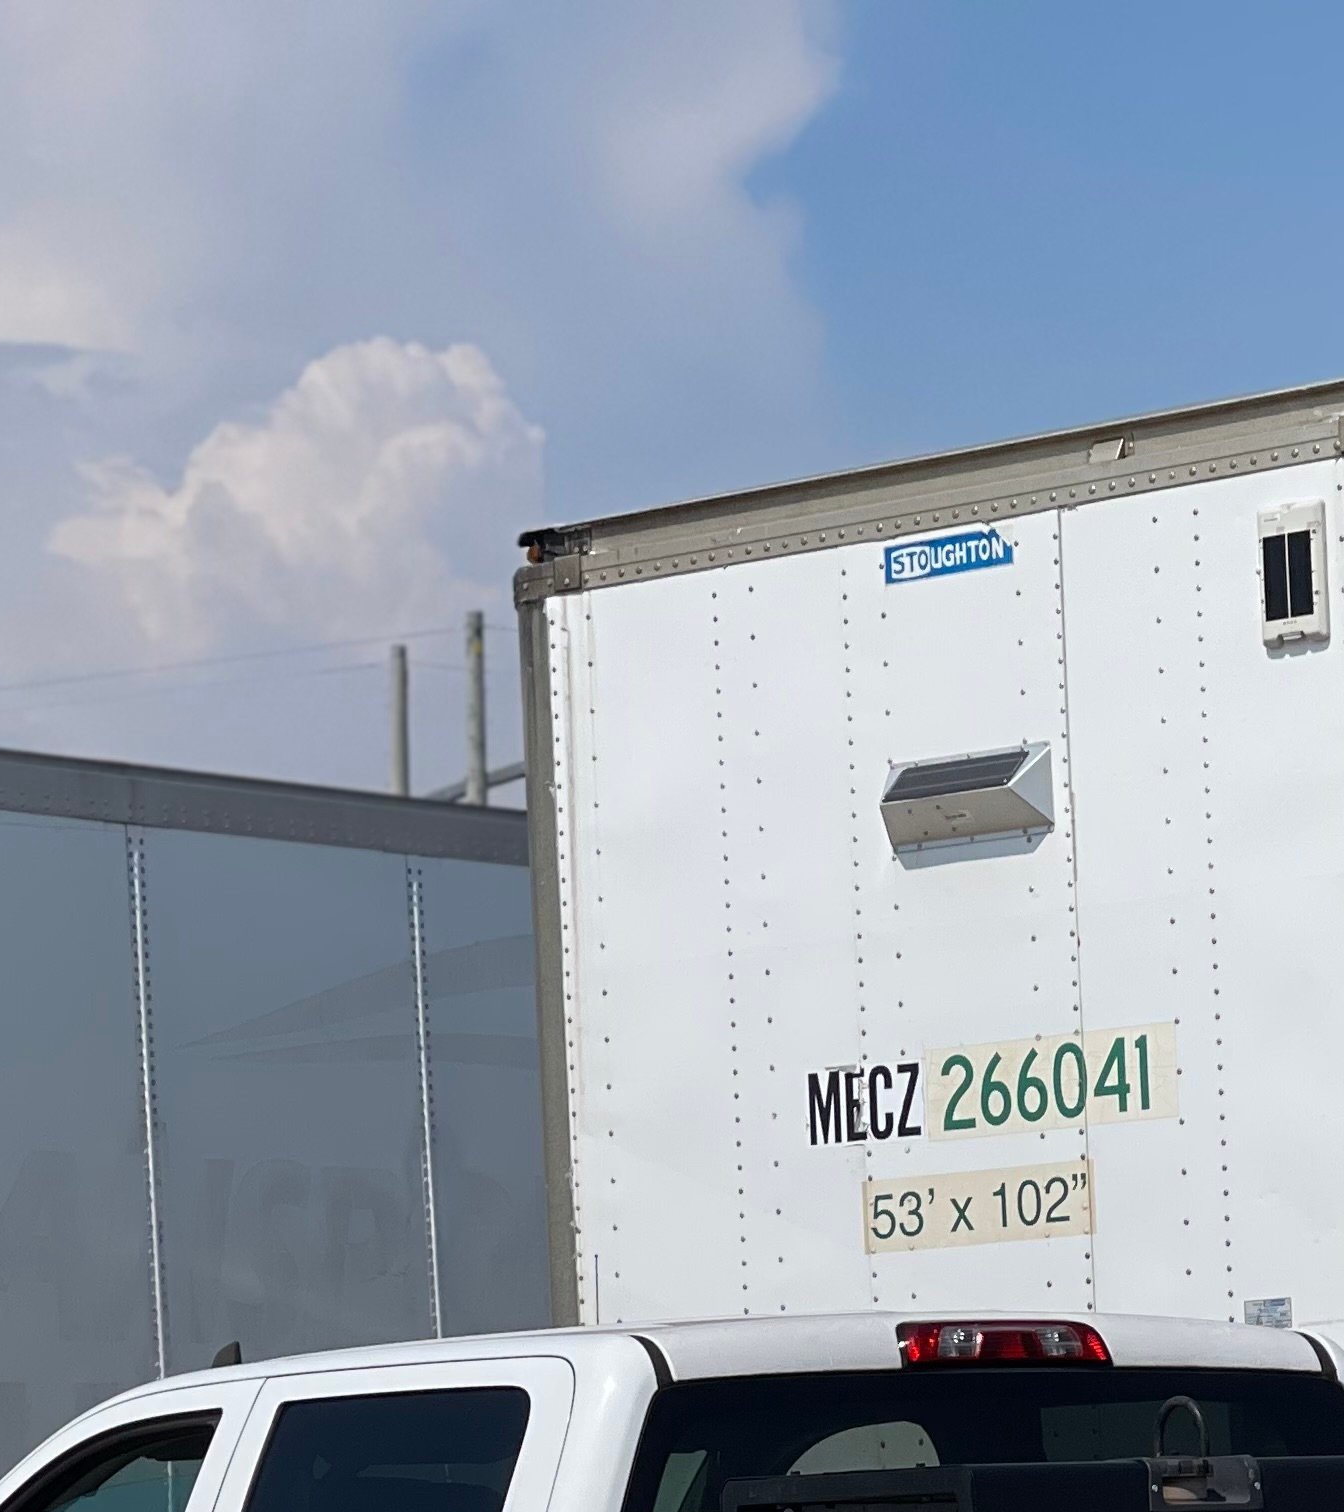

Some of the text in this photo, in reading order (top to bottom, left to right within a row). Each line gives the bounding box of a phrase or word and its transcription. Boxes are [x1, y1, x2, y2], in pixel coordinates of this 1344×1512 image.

[892, 537, 1005, 575] STOUGHTON
[807, 1034, 1151, 1146] MECZ 266041
[870, 1172, 1087, 1240] 53' x 102"
